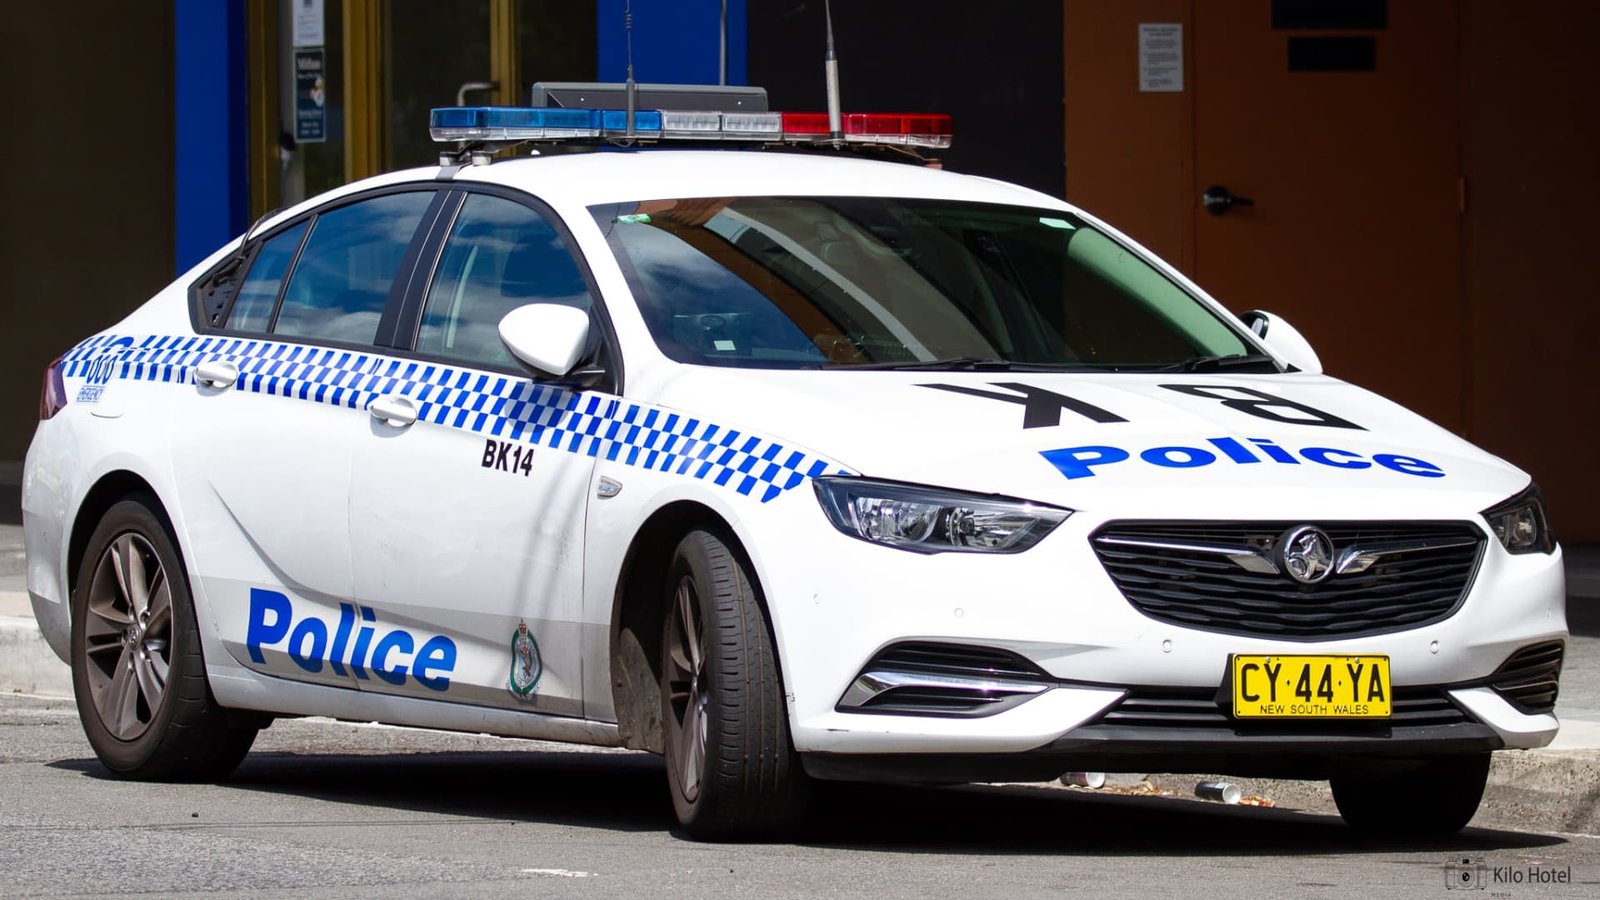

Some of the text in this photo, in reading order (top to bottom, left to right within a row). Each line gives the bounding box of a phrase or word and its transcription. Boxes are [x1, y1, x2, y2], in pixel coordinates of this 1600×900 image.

[481, 439, 534, 477] BK14
[1038, 437, 1446, 480] Police
[246, 587, 457, 692] Police
[1260, 704, 1369, 715] NEW SOUTH WALES
